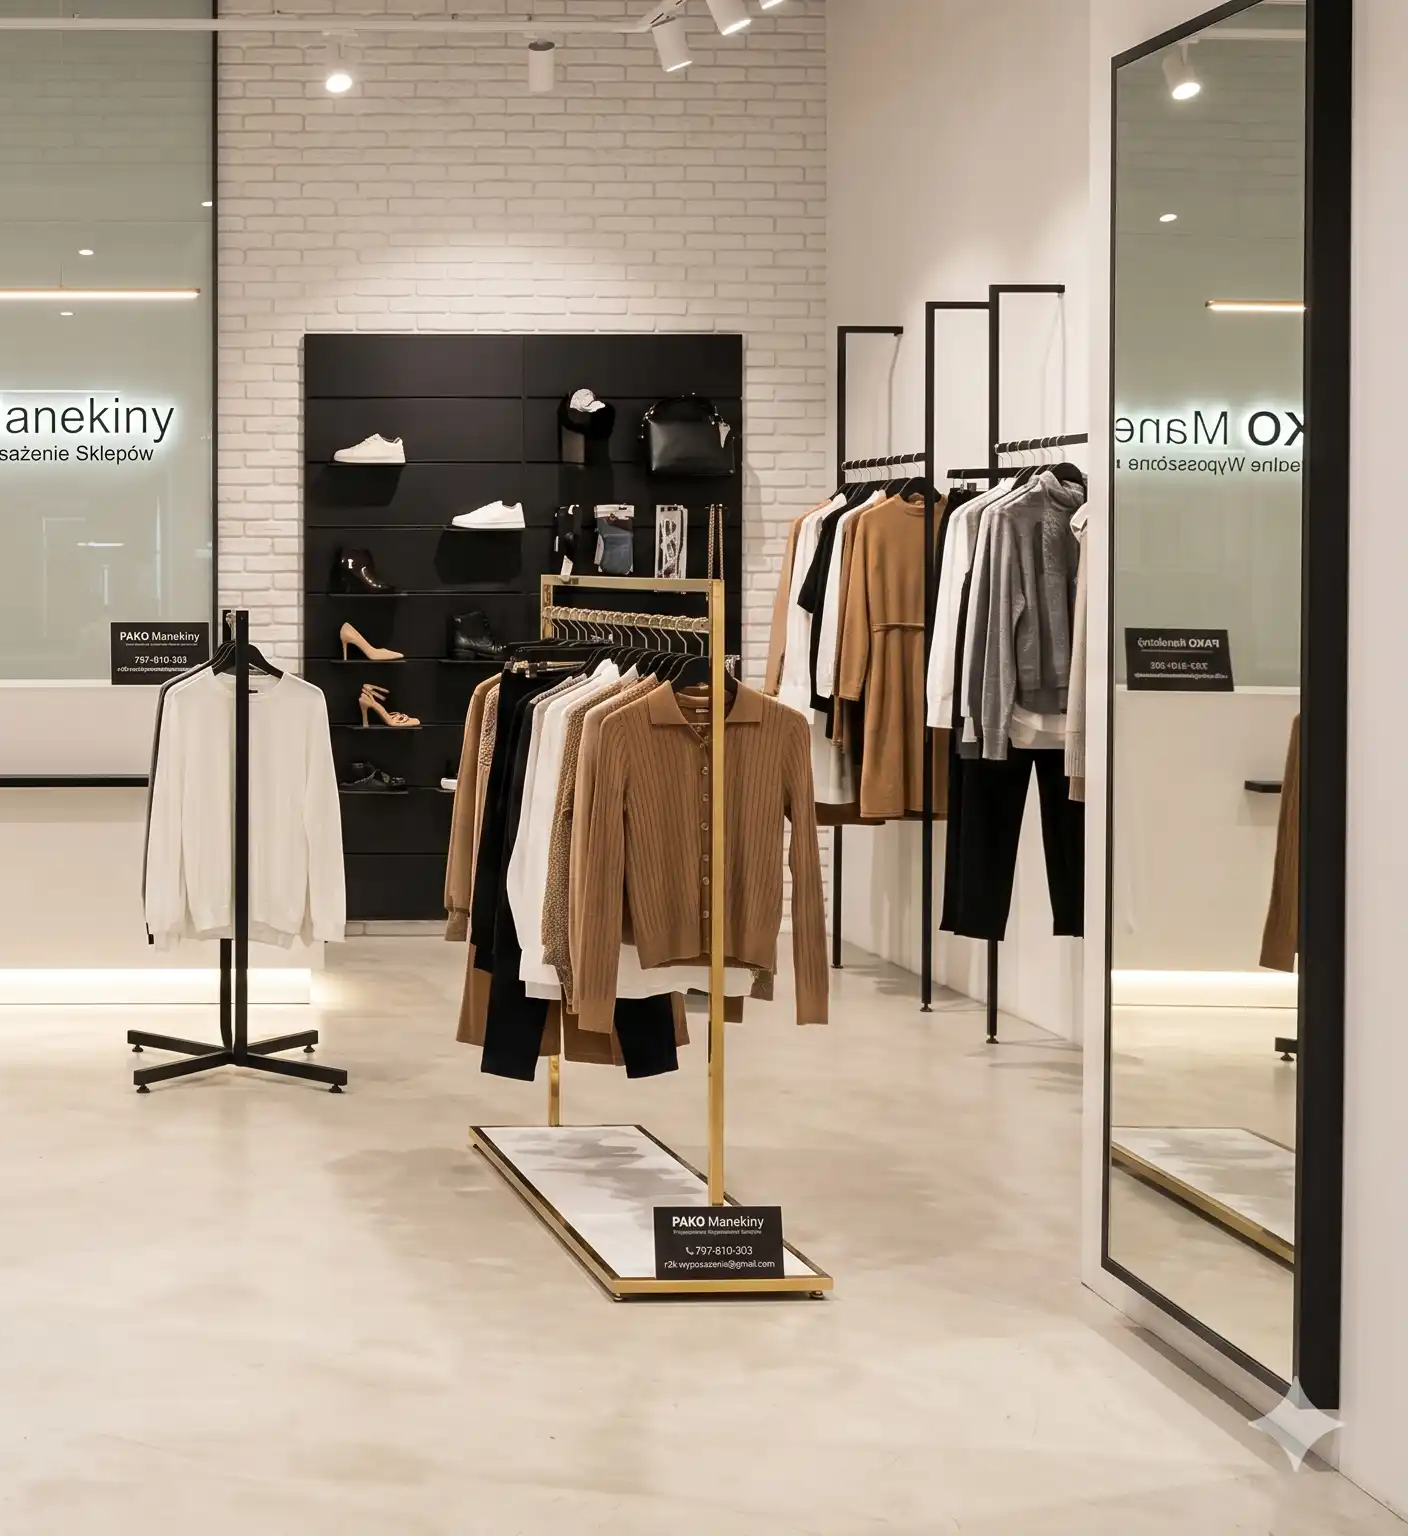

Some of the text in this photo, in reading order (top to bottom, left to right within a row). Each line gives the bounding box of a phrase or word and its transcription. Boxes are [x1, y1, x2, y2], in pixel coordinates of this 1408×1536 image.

[75, 445, 155, 463] Sklepów
[119, 631, 200, 643] PAKO Manekiny
[671, 1215, 765, 1230] PAKO Manekiny
[695, 1245, 754, 1256] 797-810-303
